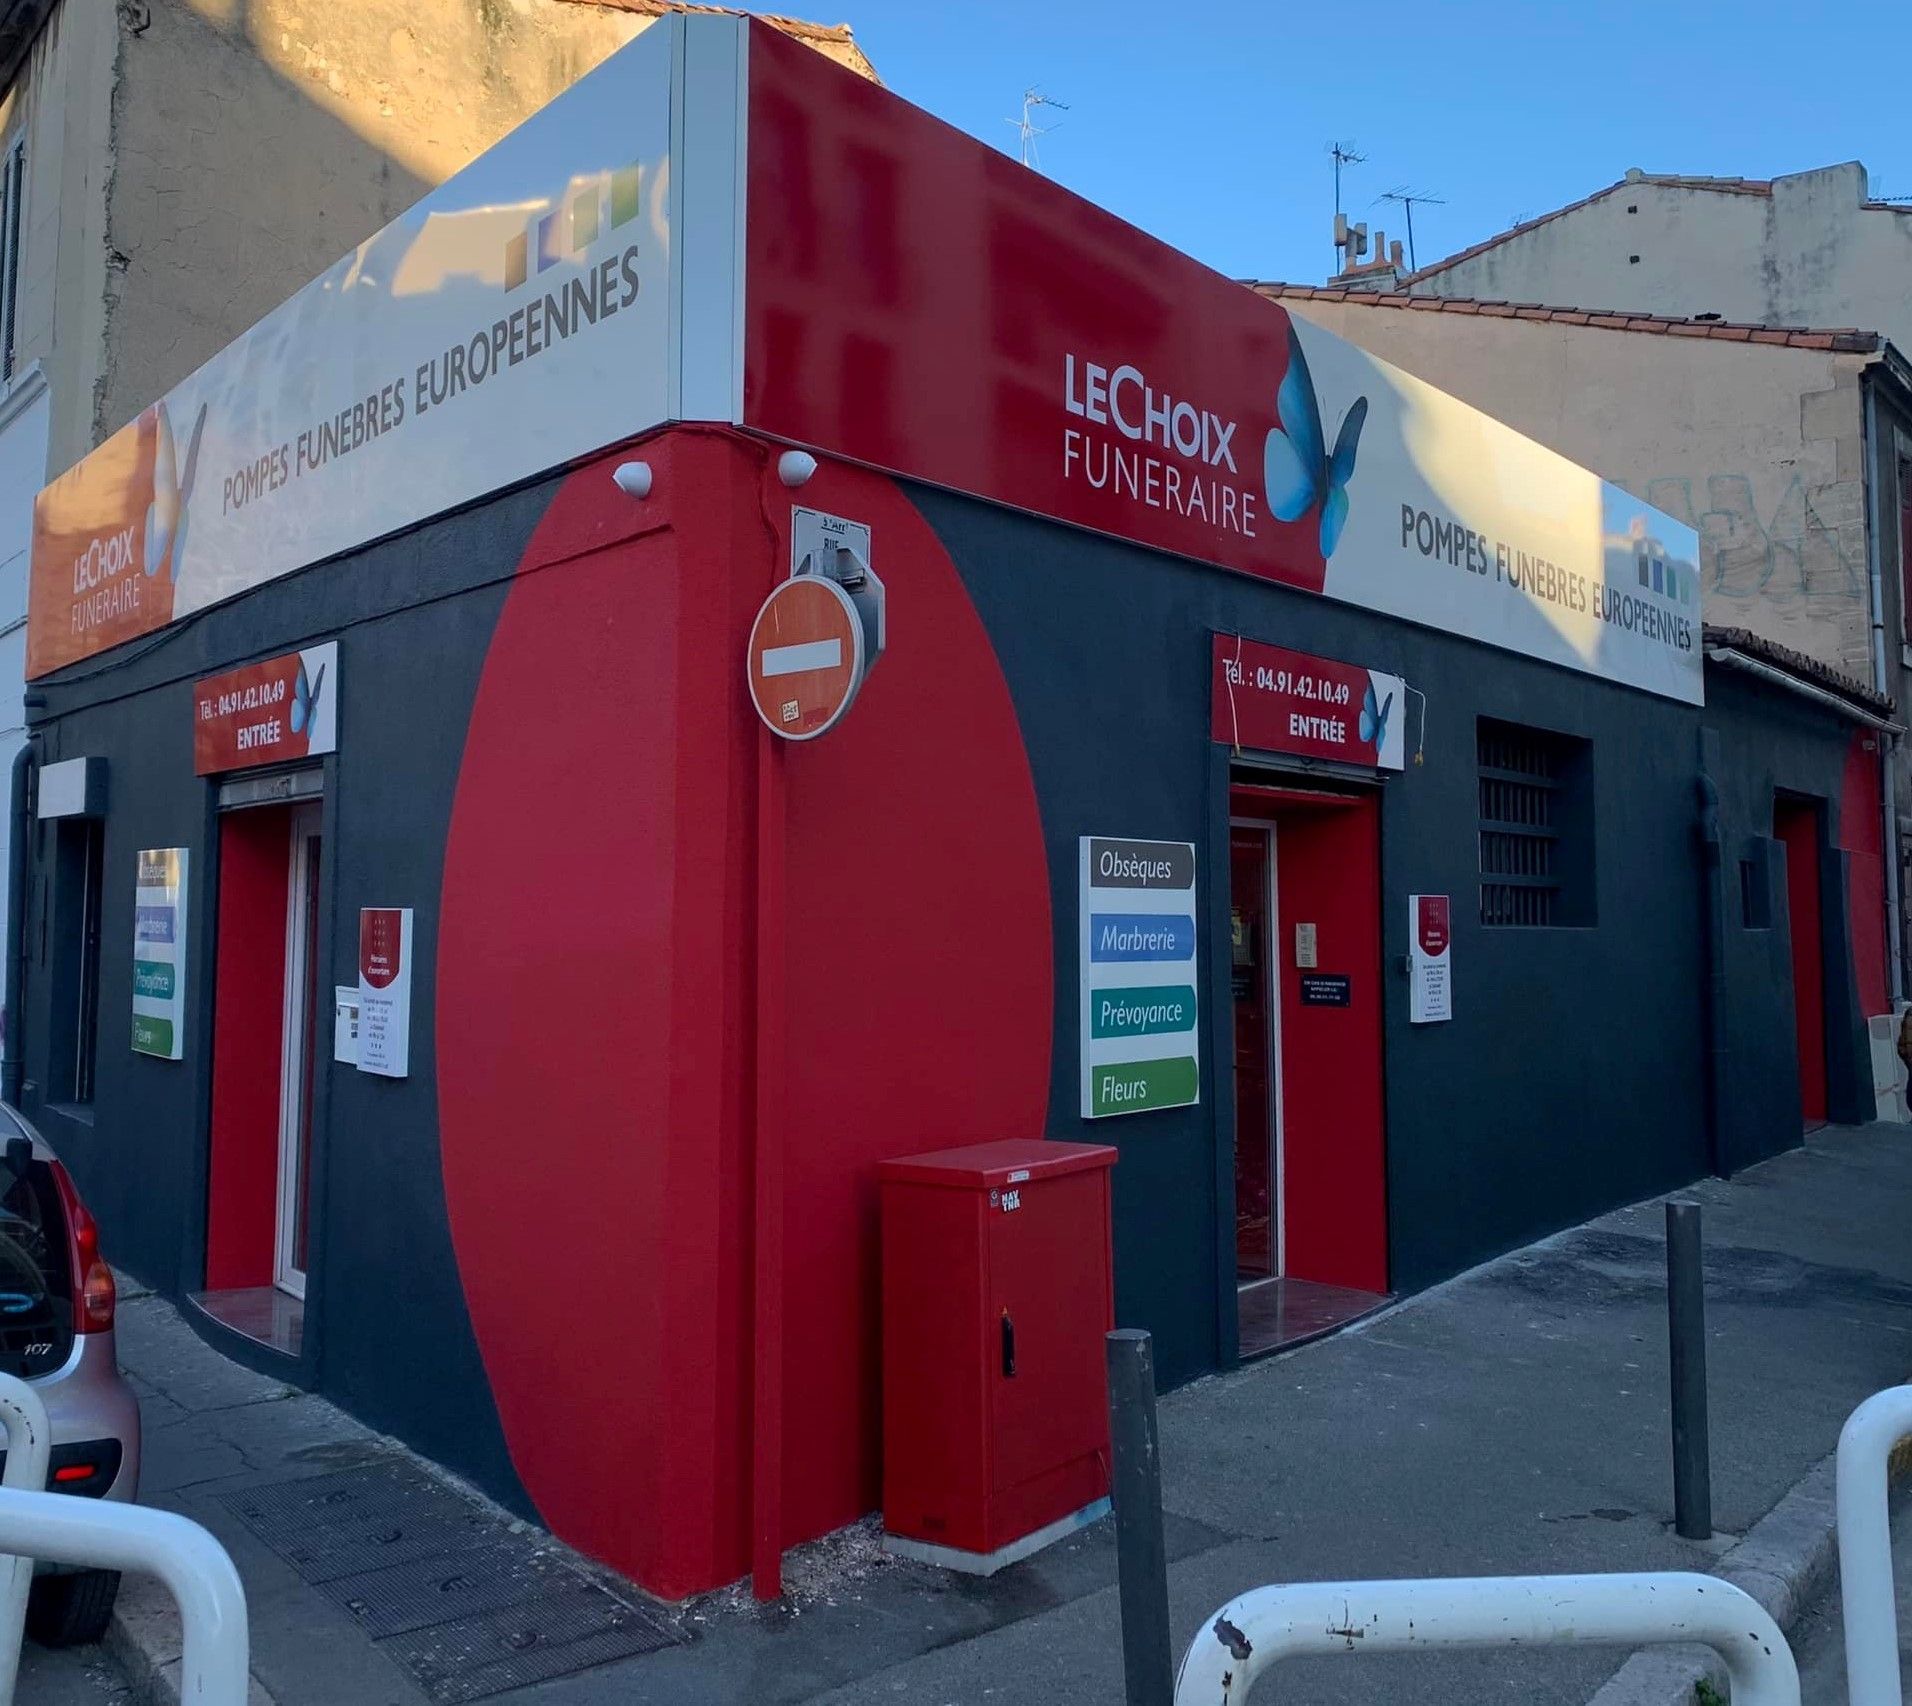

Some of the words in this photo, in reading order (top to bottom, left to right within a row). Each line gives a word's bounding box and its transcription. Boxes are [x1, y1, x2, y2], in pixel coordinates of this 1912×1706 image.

[223, 443, 288, 516] POMPES
[296, 377, 405, 477] FUNEBRES
[415, 245, 639, 416] EUROPEENNES
[1065, 429, 1256, 537] FUNERAIRE
[1402, 503, 1487, 576] POMPES
[1496, 542, 1586, 613] FUNEBRES
[1592, 581, 1692, 652] EUROPEENNES
[71, 573, 141, 635] FUNERAIRE
[218, 679, 285, 717] 04.91.42.10.49
[1256, 666, 1349, 705] 04.91.42.10.49
[237, 716, 281, 750] ENTRÉE
[1289, 713, 1346, 743] ENTRÉE
[1100, 850, 1172, 885] Obsèques
[1101, 926, 1175, 951] Marbrerie
[1101, 1000, 1183, 1032] Prévoyance
[1102, 1076, 1147, 1103] Fleurs
[24, 1343, 52, 1356] 107
